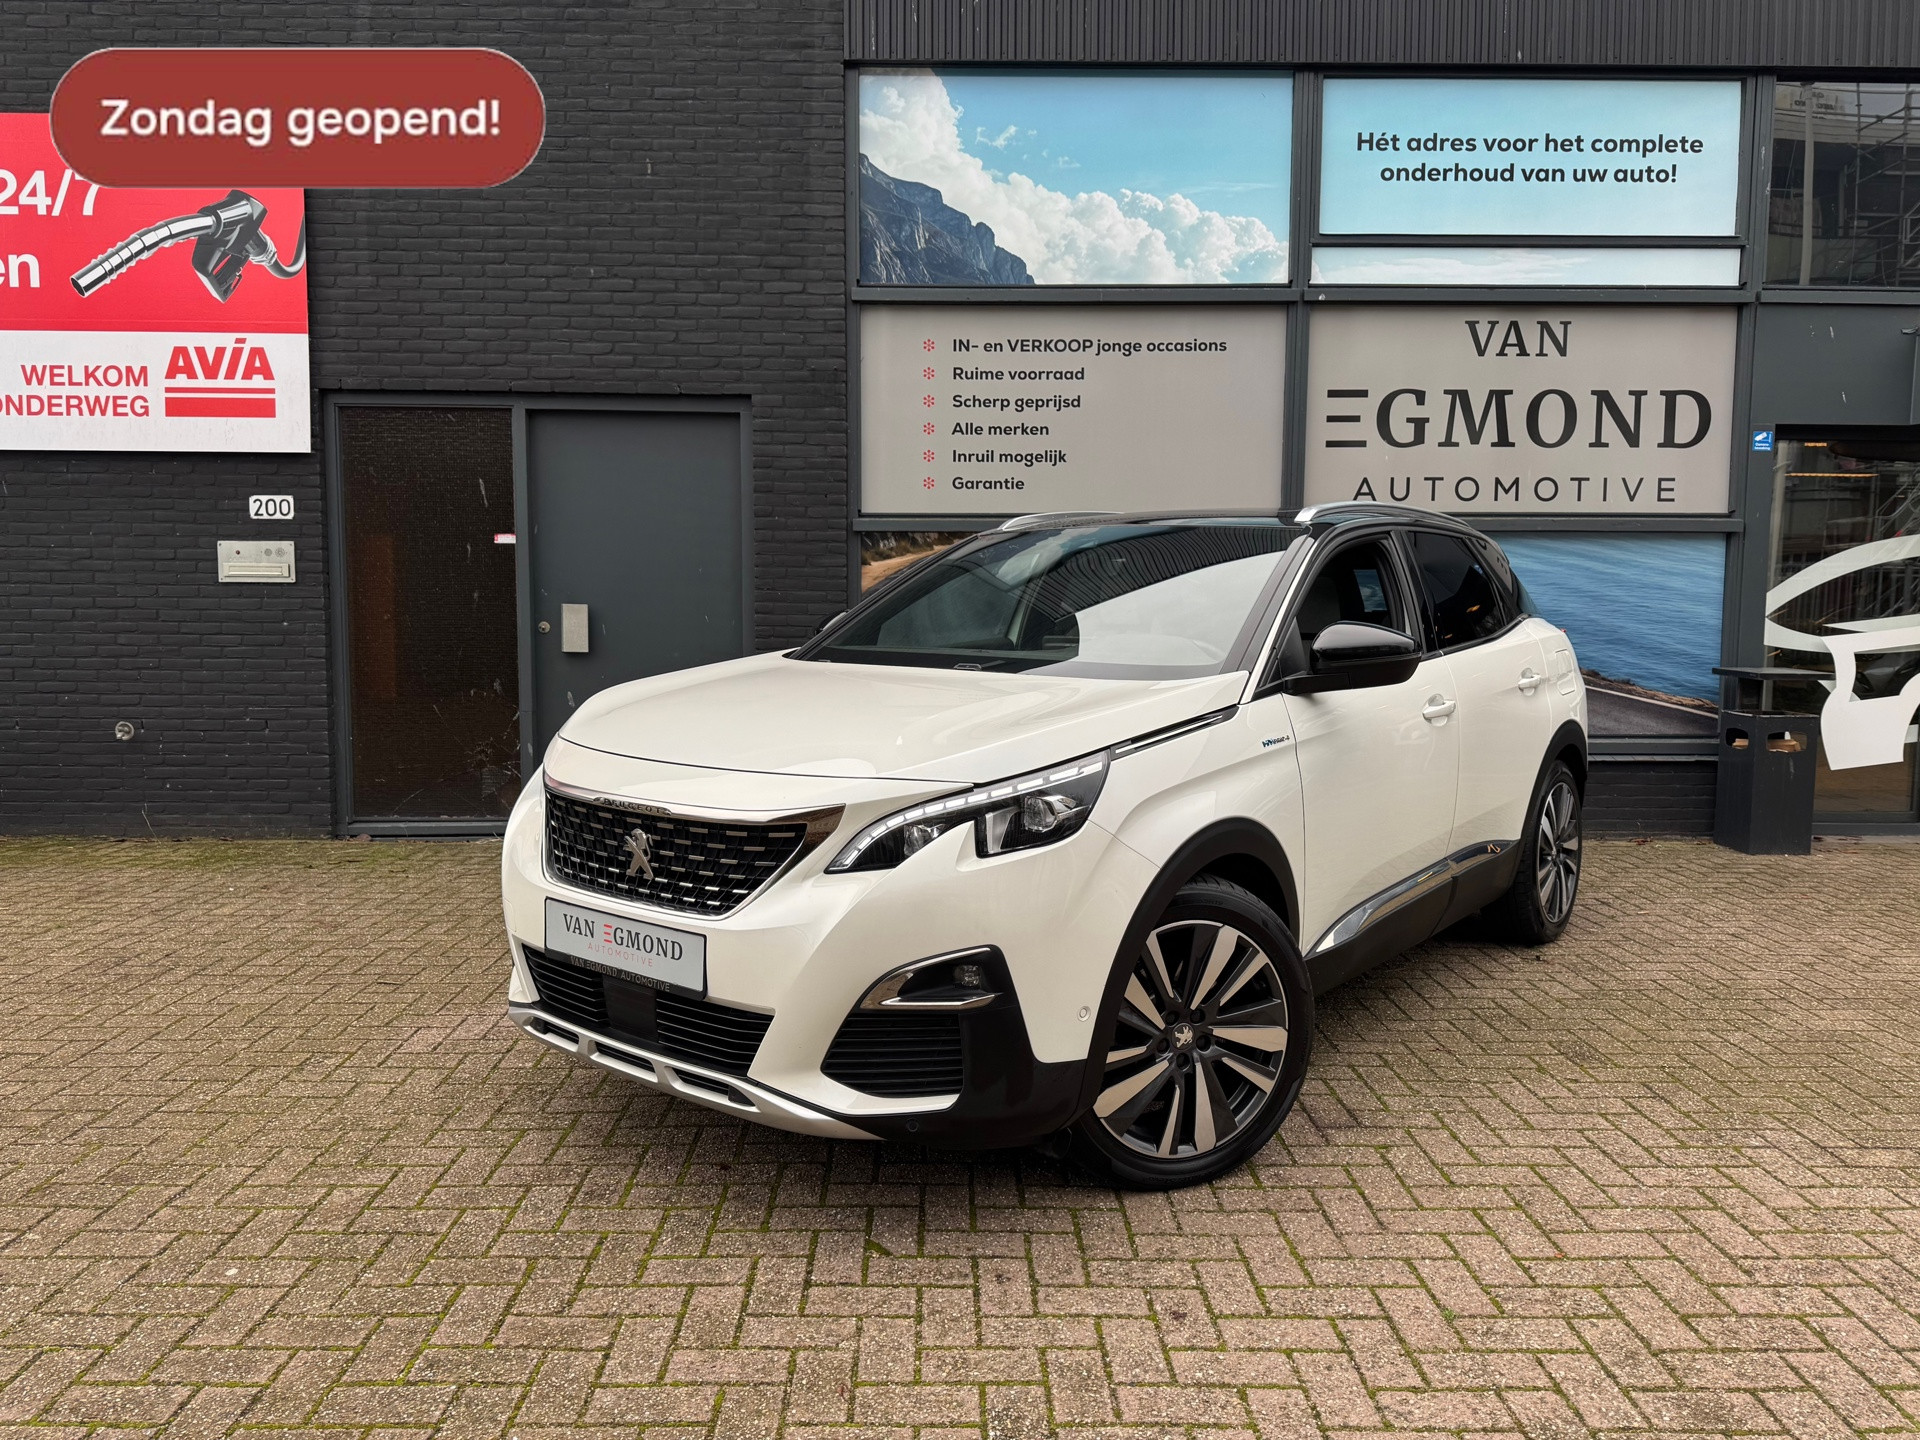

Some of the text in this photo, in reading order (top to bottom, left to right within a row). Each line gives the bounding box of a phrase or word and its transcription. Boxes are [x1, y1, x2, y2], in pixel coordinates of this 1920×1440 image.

[1357, 132, 1704, 158] Hét adres voor het complete
[1380, 162, 1678, 183] onderhoud van uw auto!
[952, 339, 1228, 356] IN- en VERKOOP jonge occasions
[1464, 320, 1573, 357] VAN
[20, 364, 149, 387] WELKOM
[952, 367, 1085, 381] Ruime voorraad
[0, 394, 150, 418] NDERWEG
[952, 394, 1082, 413] Scherp geprijsd
[951, 422, 1050, 436] Alle merken
[1325, 388, 1713, 450] EGMOND
[952, 449, 1067, 467] Inruil mogelijk
[952, 476, 1025, 490] Garantie
[1353, 475, 1677, 502] AUTOMOTIVE
[253, 498, 291, 517] 200
[563, 913, 683, 961] VAN EGMOND
[587, 942, 653, 967] AUTOMOTIVE
[570, 955, 585, 968] VAN
[620, 970, 670, 993] AUTOMOTIVE
